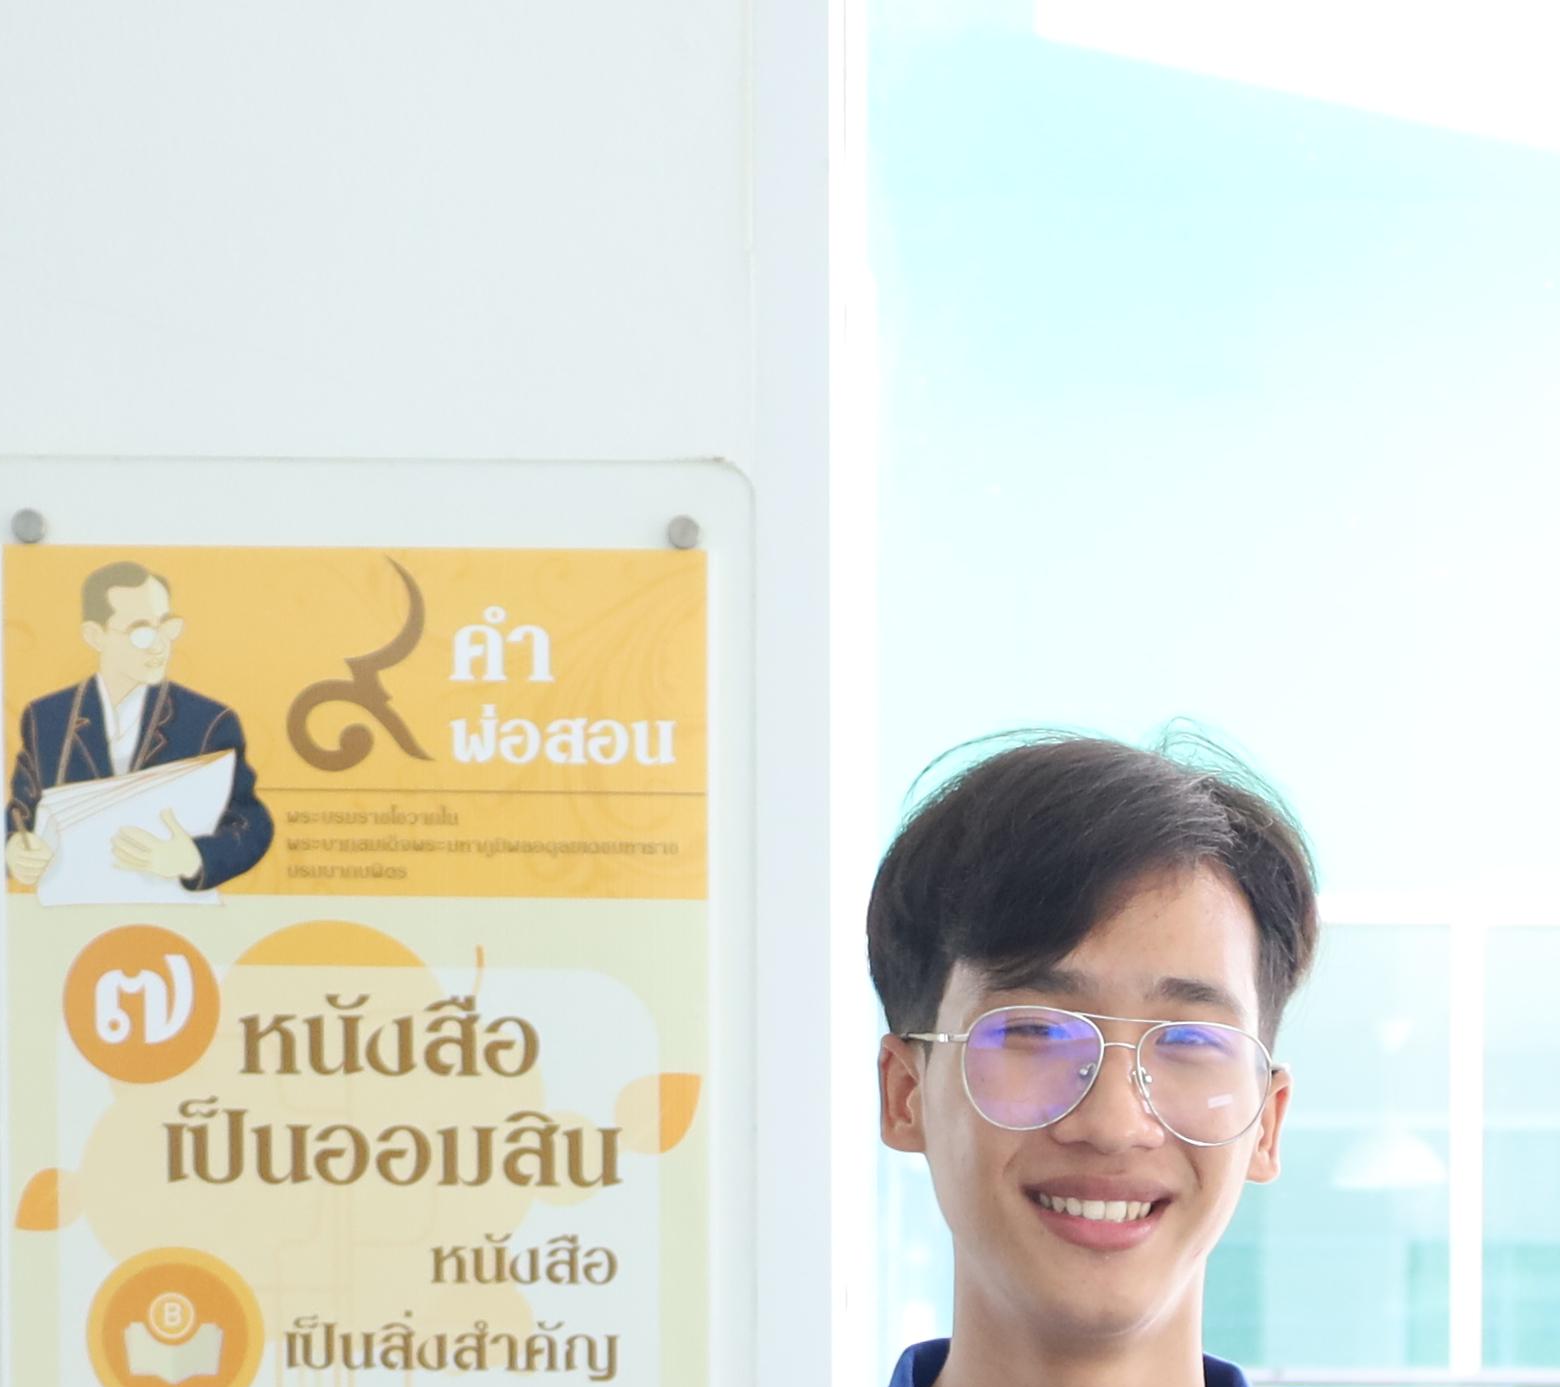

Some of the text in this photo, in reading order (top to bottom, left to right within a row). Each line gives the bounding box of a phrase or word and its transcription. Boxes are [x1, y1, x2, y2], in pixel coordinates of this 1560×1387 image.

[449, 606, 555, 683] คำ
[449, 705, 677, 764] พ่อสอน
[239, 994, 540, 1078] หนังสือ
[163, 1096, 623, 1188] เป็นออมสิน
[430, 1234, 619, 1286] หนังสือ
[284, 1310, 620, 1382] เป็นสิ่งสำคัญ
